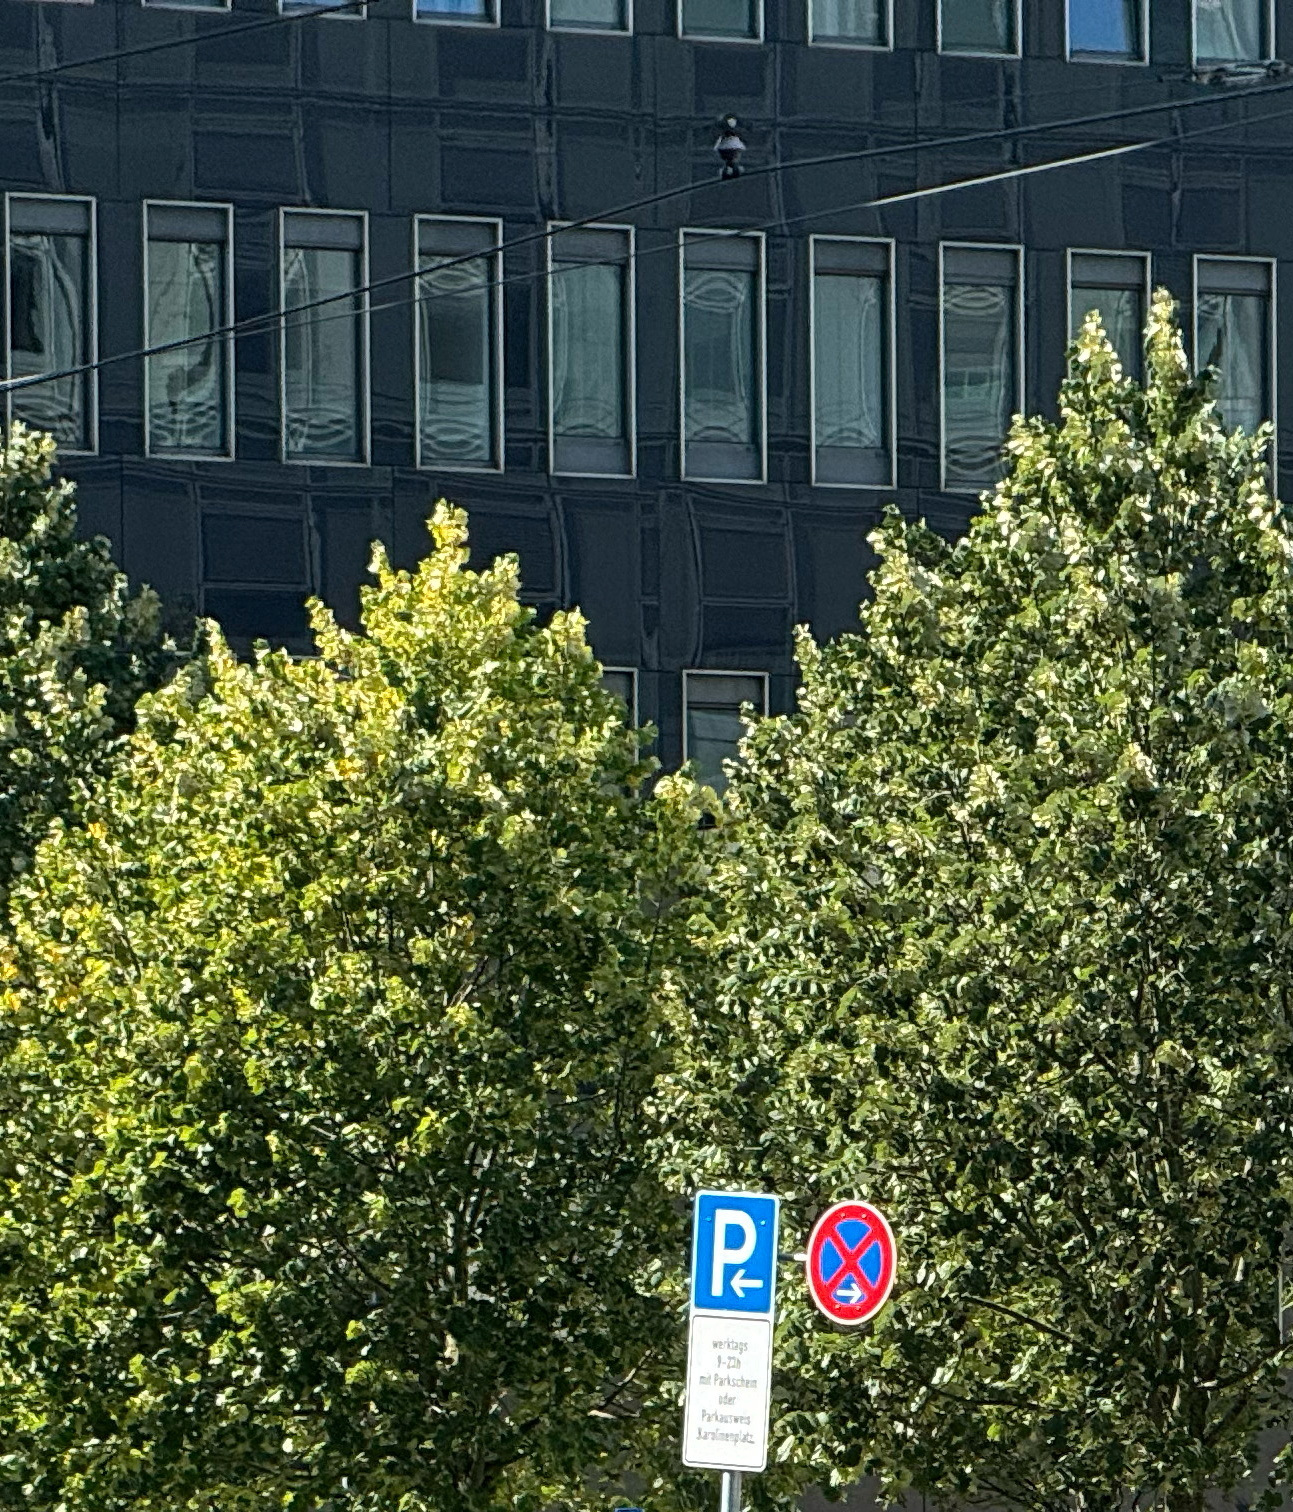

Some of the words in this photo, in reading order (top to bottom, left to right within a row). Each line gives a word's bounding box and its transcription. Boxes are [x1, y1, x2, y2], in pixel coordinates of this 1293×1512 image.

[711, 1208, 757, 1297] P
[712, 1338, 748, 1355] werktags
[714, 1373, 757, 1388] Parkschein
[718, 1392, 736, 1405] oder
[701, 1409, 751, 1425] Parkausweis
